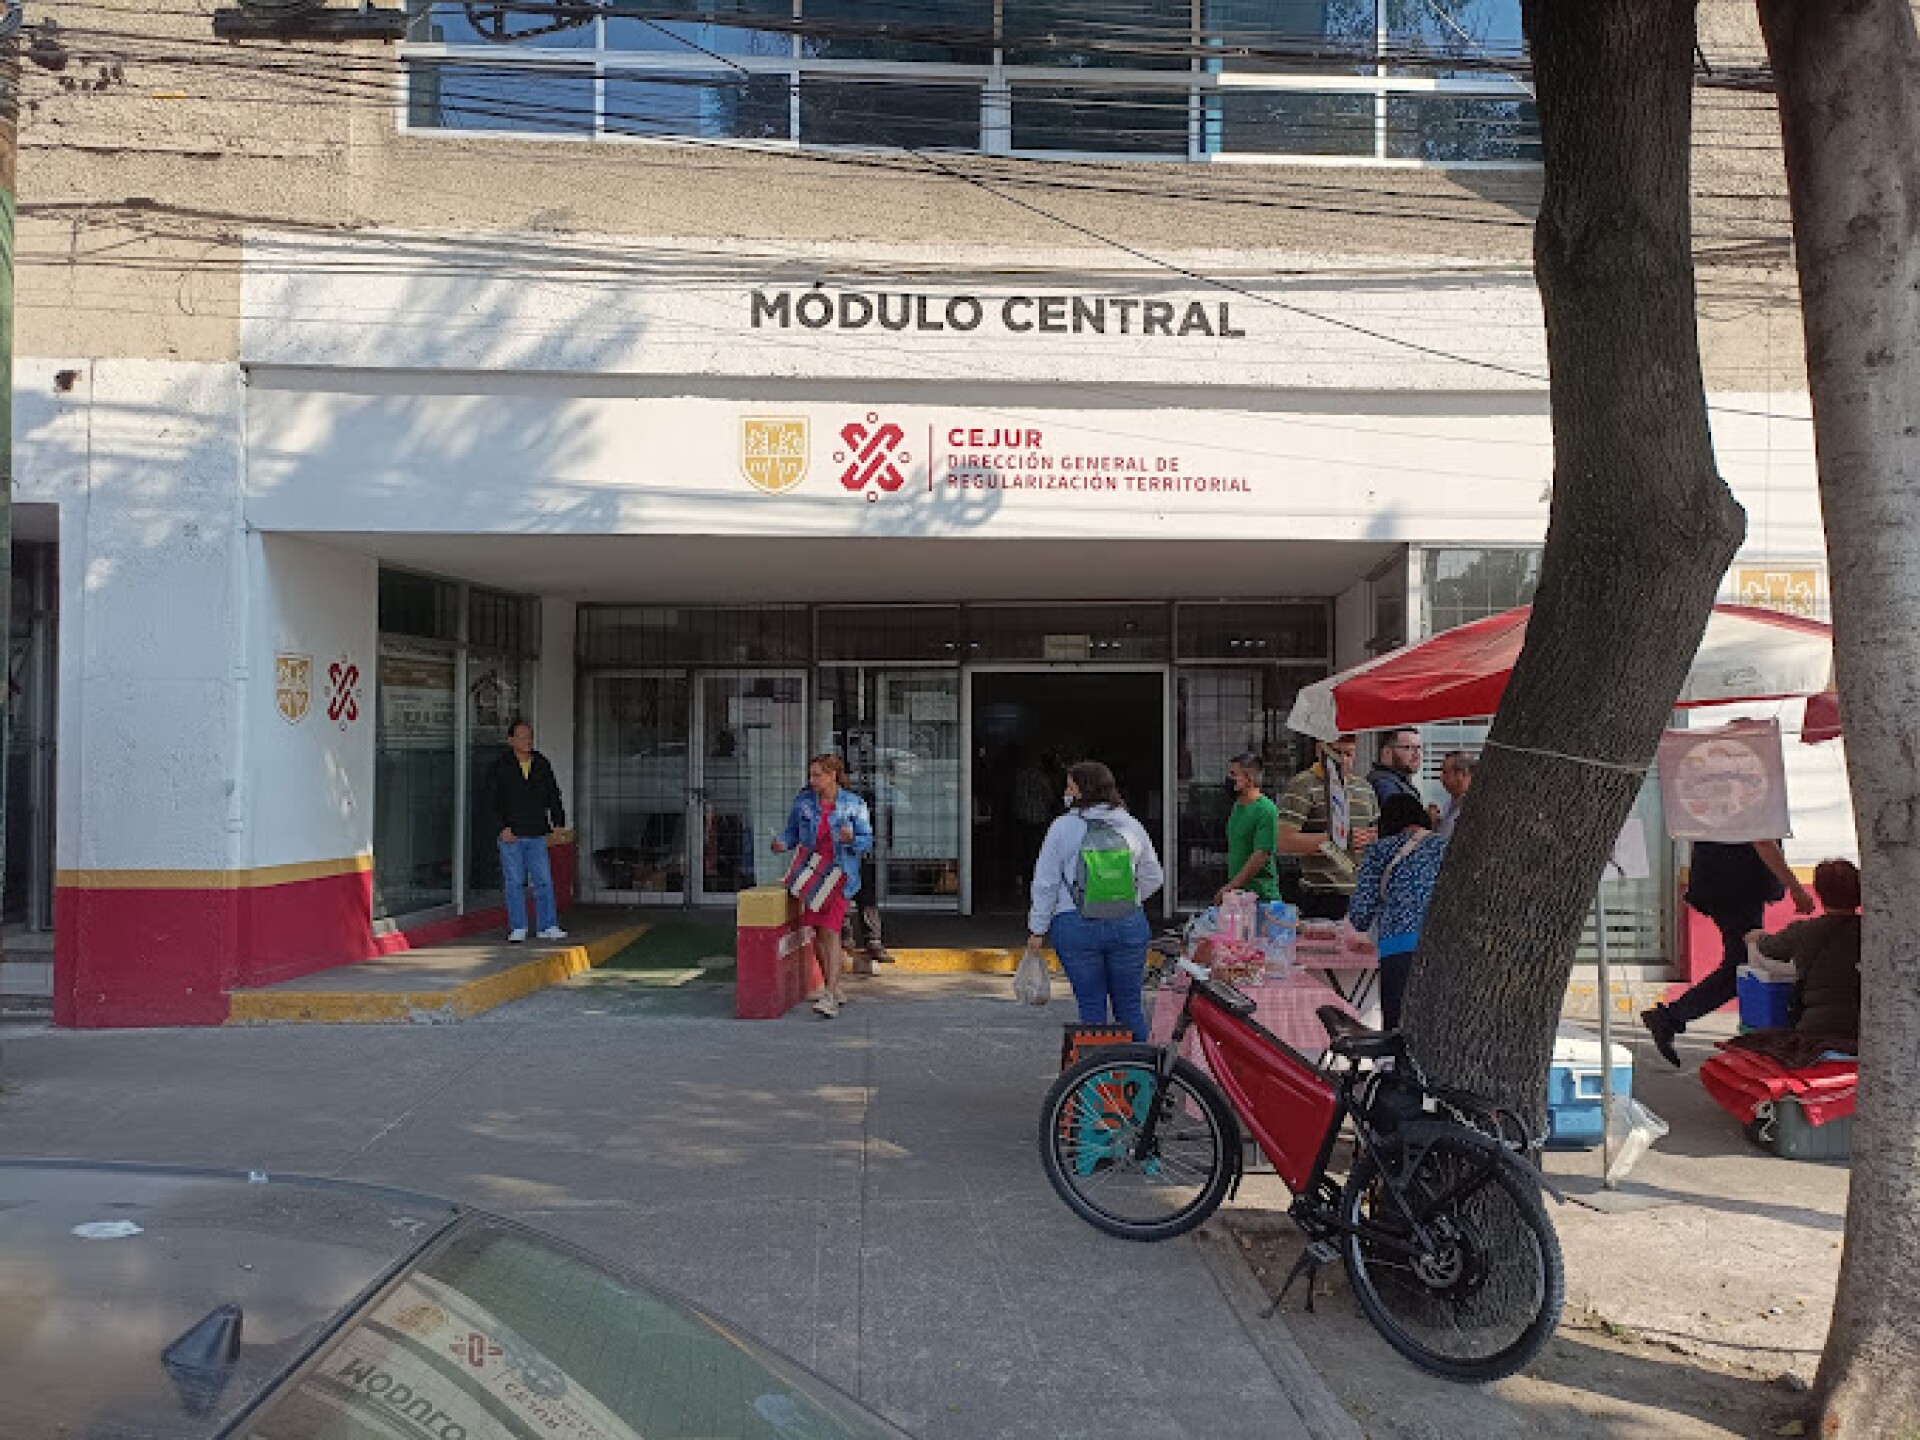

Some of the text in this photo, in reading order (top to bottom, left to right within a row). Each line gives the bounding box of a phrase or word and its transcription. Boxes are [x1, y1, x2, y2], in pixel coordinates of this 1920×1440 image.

[750, 283, 1246, 337] MÓDULO CENTRAL
[948, 428, 1043, 449] CEJUR
[948, 453, 1179, 472] DIRECCIÓN GENERAL DE
[948, 472, 1252, 492] REGULARIZACIÓN TERRITORIAL
